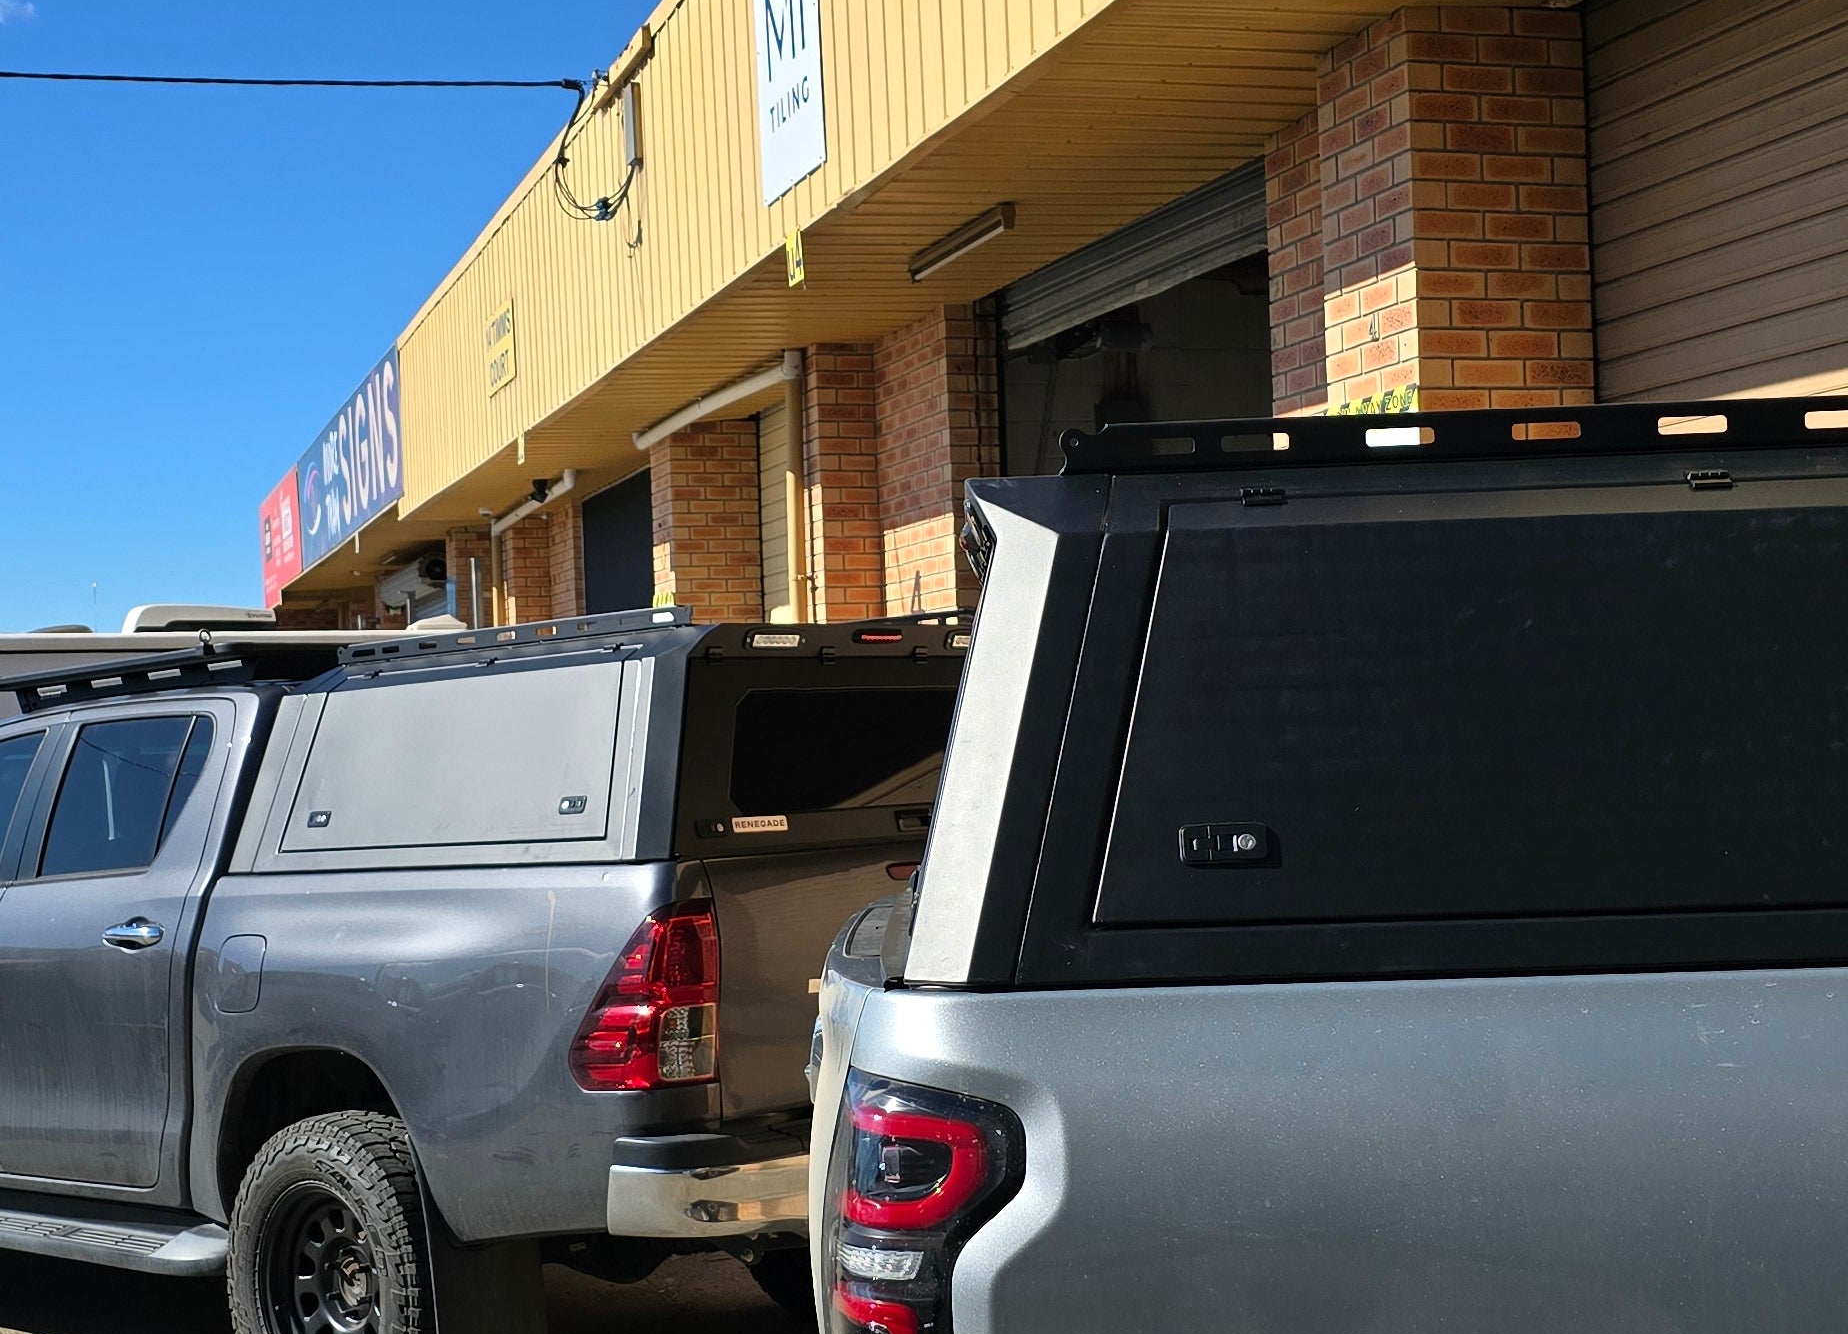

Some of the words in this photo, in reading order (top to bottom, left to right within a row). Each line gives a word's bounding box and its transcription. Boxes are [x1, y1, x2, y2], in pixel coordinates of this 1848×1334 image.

[769, 75, 810, 133] TILING
[786, 231, 802, 281] U4
[1384, 389, 1414, 411] ZONE
[338, 360, 399, 525] SIGNS
[734, 819, 785, 829] RENEGADE
